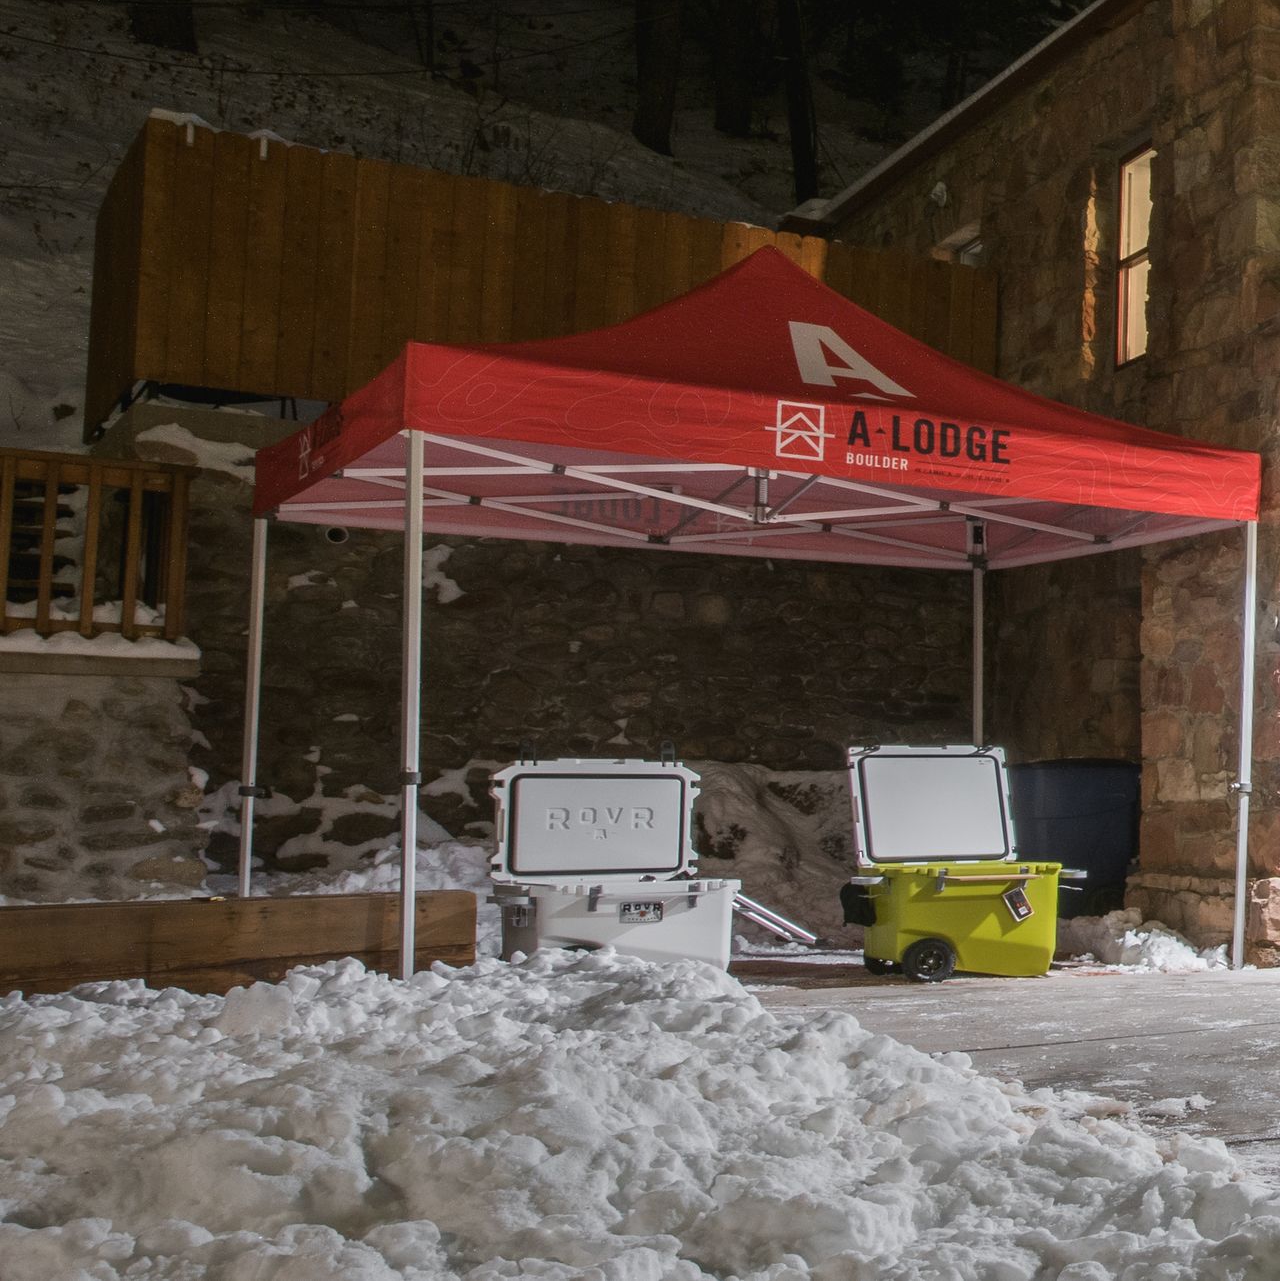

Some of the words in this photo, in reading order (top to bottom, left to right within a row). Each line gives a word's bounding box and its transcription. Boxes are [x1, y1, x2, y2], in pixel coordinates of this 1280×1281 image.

[788, 320, 918, 399] A
[846, 452, 908, 471] BOULDER
[545, 807, 655, 830] ROVR
[623, 903, 663, 912] ROVR
